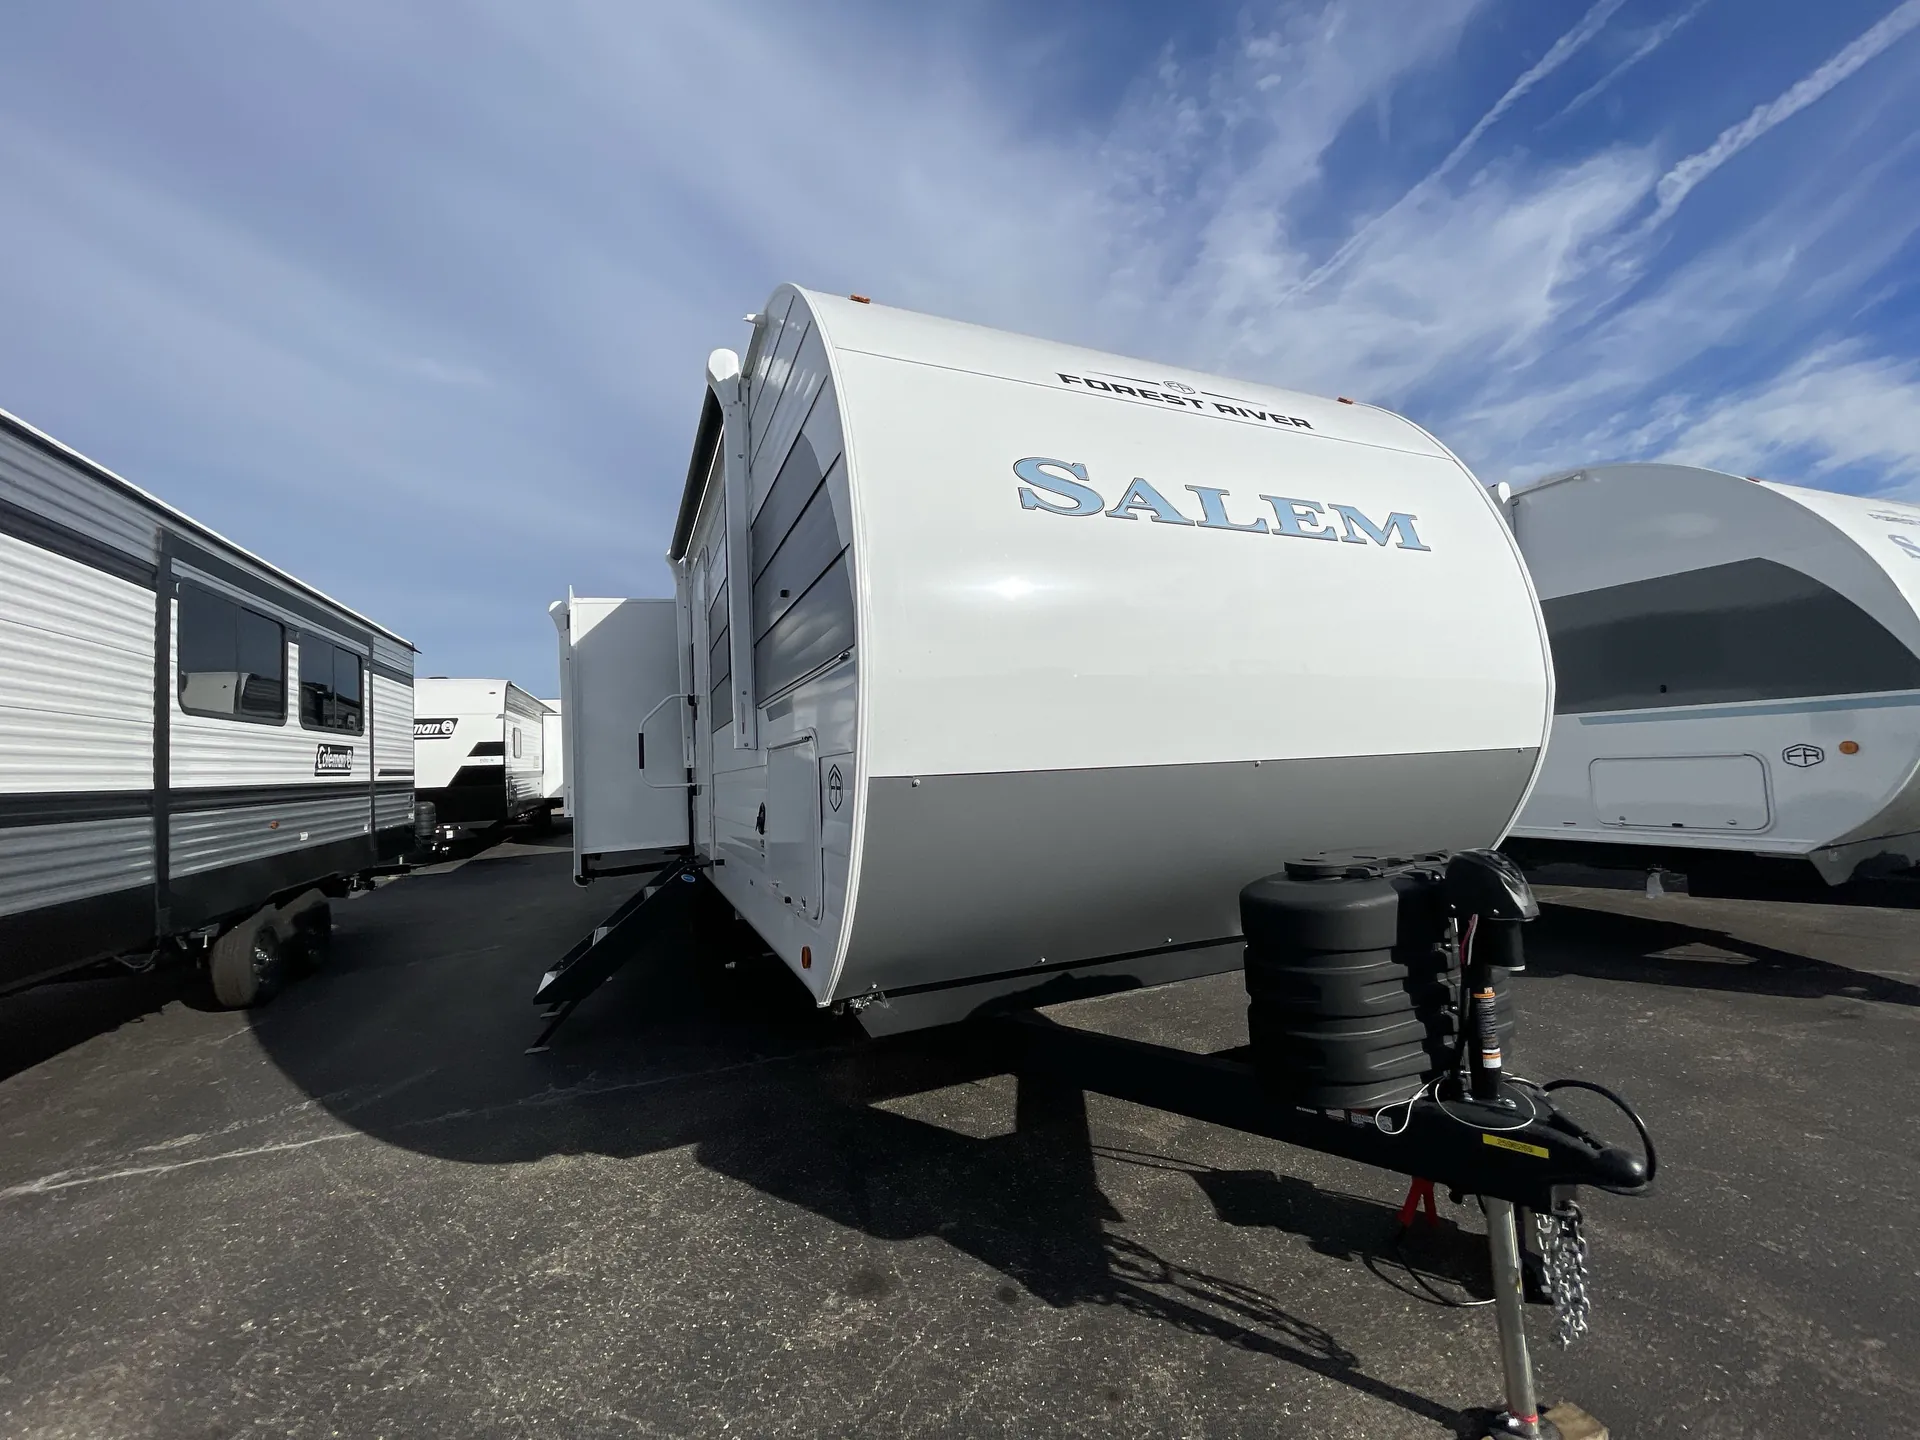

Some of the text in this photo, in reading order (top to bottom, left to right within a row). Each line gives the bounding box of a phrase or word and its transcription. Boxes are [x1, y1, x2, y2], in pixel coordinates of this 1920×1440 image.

[1054, 371, 1315, 430] FOREST RIVER
[1012, 456, 1432, 553] SALEM
[317, 745, 347, 769] Coleman
